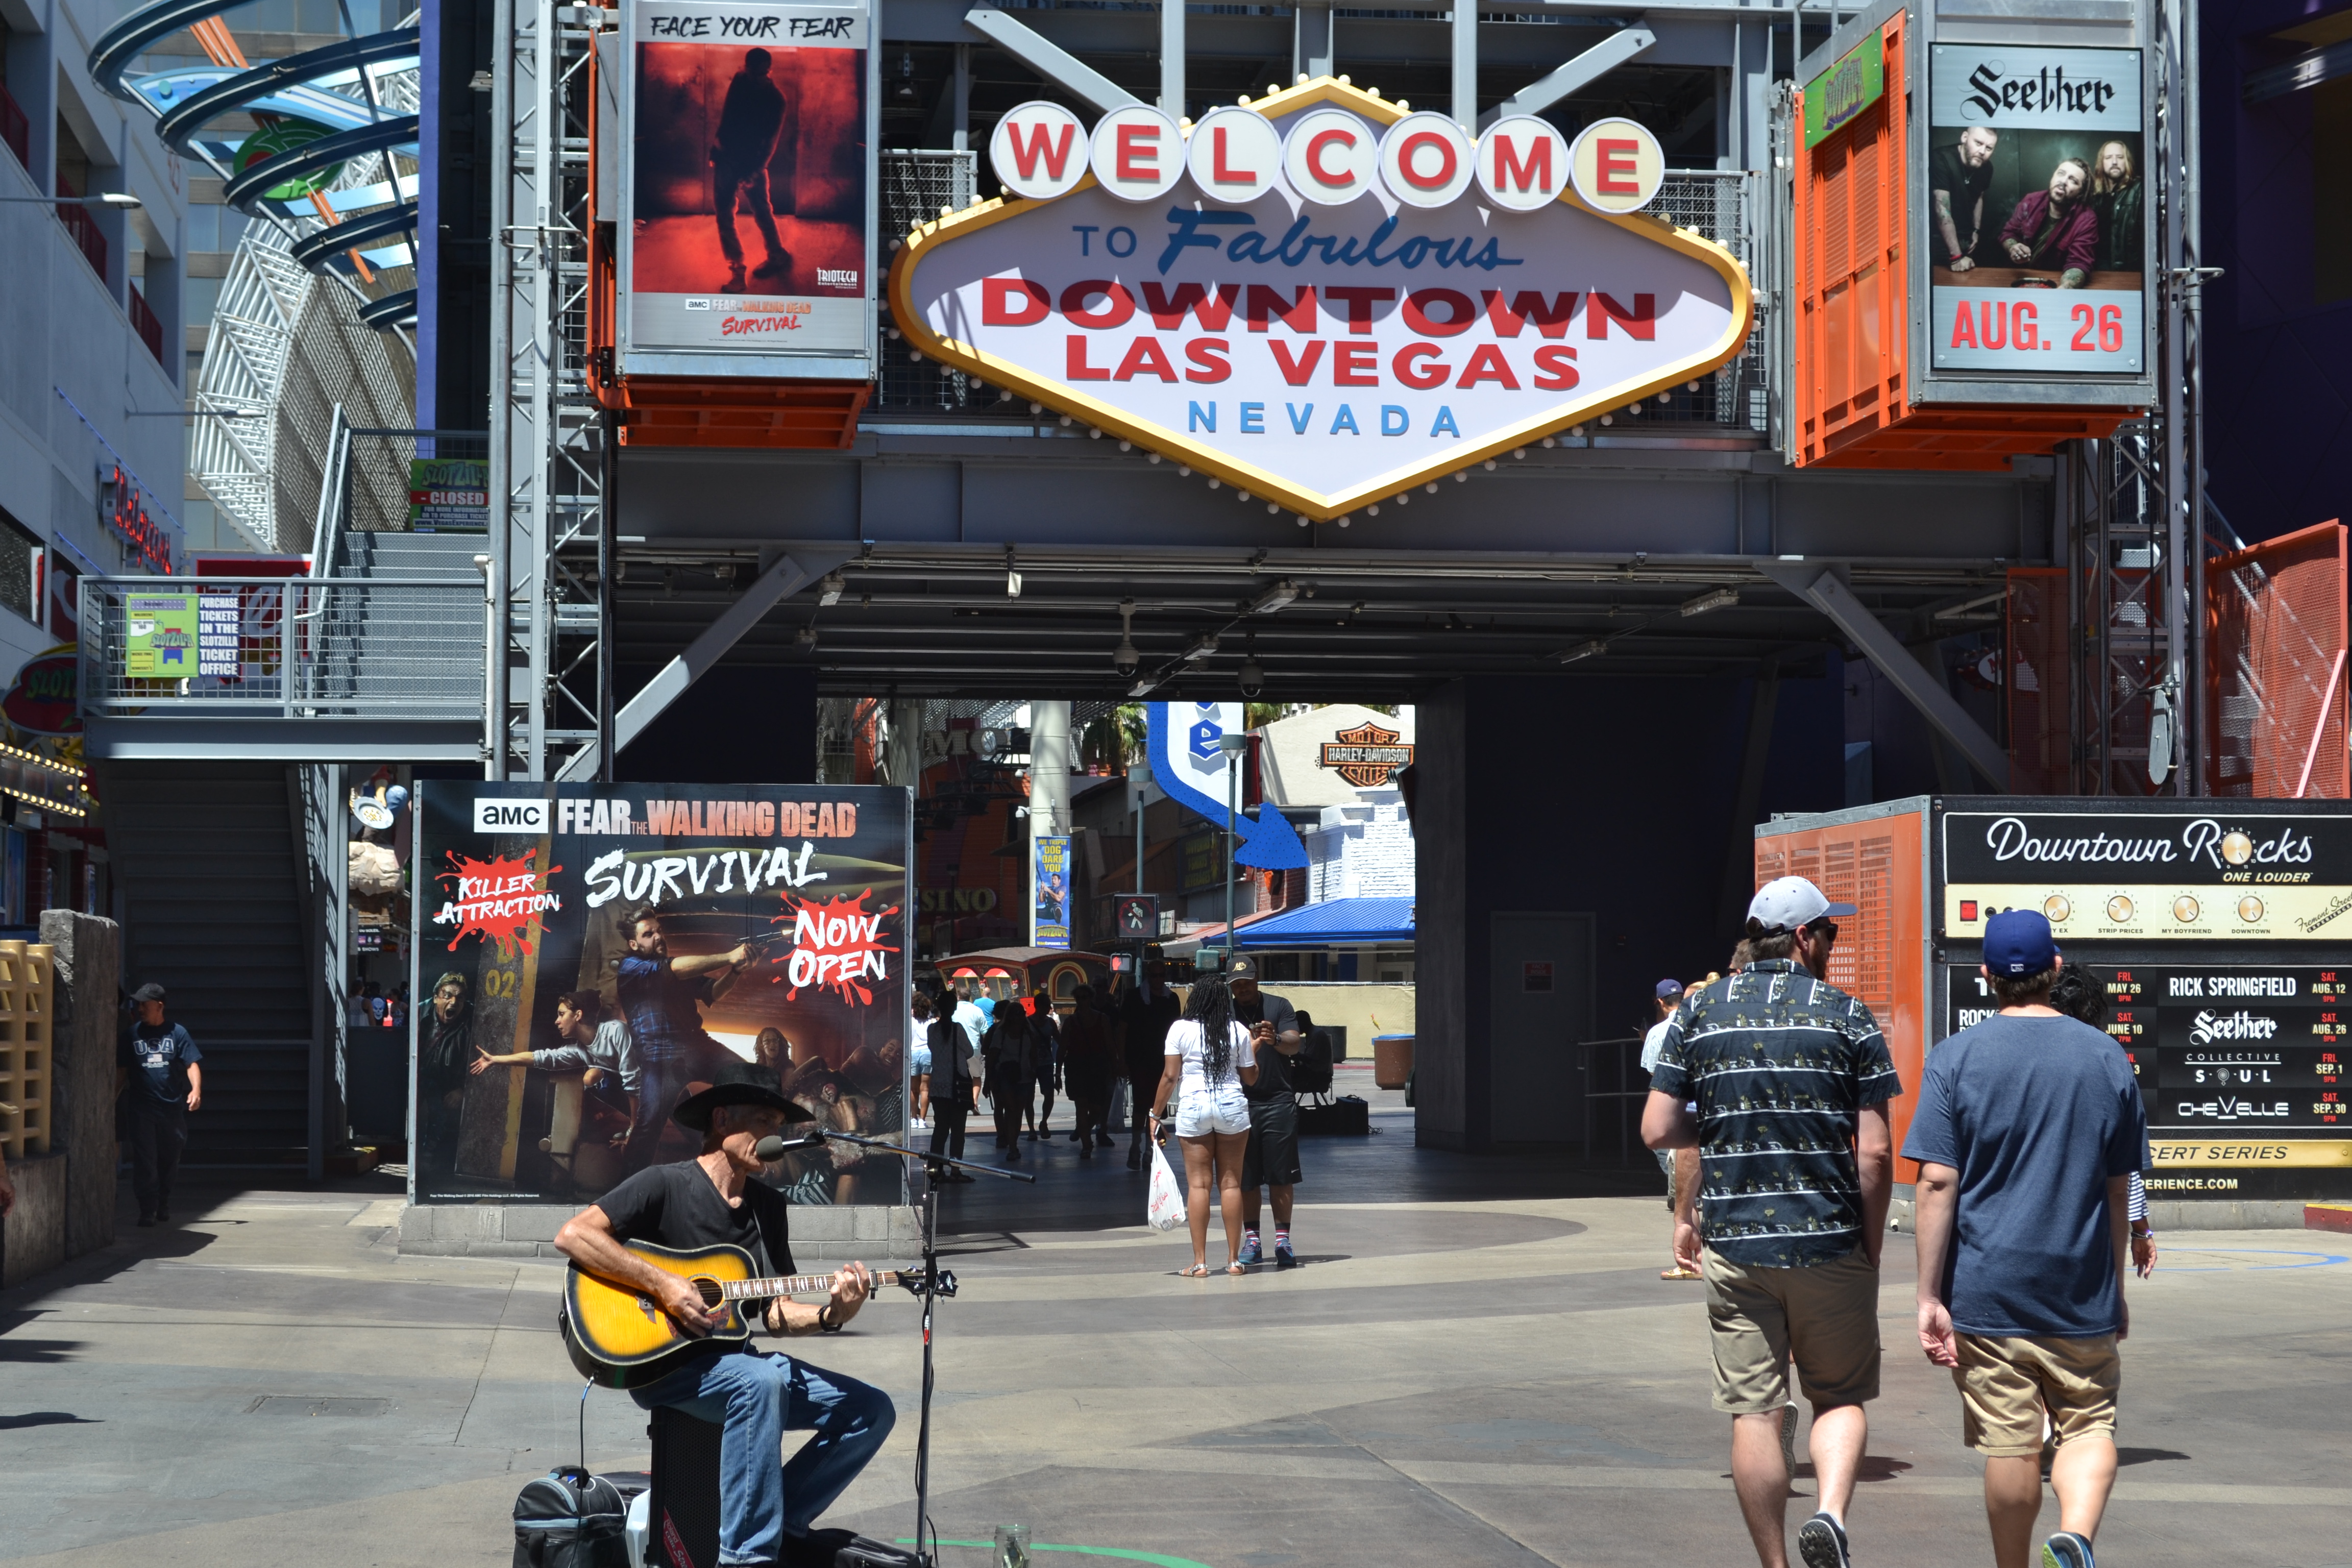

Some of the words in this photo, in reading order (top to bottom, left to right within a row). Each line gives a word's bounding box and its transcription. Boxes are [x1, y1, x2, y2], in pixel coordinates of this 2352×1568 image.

[651, 16, 712, 36] FACE
[720, 16, 780, 38] YOUR
[790, 17, 854, 39] FEAR
[1958, 60, 2116, 119] Seether
[1008, 122, 1639, 193] WELCOME
[1072, 226, 1138, 258] TO
[1159, 206, 1524, 276] Fabulous
[817, 268, 857, 282] TRIOTECH
[713, 300, 737, 311] FEAR
[743, 301, 784, 313] WALKING
[786, 302, 811, 313] DEAD
[982, 278, 1656, 341] DOWNTOWN
[722, 314, 801, 335] SURVIVAL
[1951, 301, 2051, 350] AUG.
[2071, 304, 2122, 352] 26
[1066, 335, 1232, 384] LAS
[1268, 340, 1580, 390] VEGAS
[1189, 400, 1460, 438] NEVADA
[430, 492, 484, 505] CLOSED
[200, 597, 238, 608] PURCHASE
[200, 610, 238, 621] TICKETS
[200, 623, 212, 633] IN
[214, 624, 238, 633] THE
[200, 636, 238, 646] SLOTZILLA
[200, 649, 238, 661] TICKET
[200, 664, 237, 675] OFFICE
[1348, 728, 1389, 743] MOTOR
[1329, 748, 1409, 762] HARLEY-DAVIDSON
[558, 799, 631, 834] FEAR
[631, 821, 648, 835] THE
[646, 800, 774, 837] WALKING
[781, 802, 856, 838] DEAD
[1987, 818, 2177, 862] Downtown
[1044, 846, 1061, 854] DOG
[1042, 855, 1063, 863] DARE
[584, 841, 827, 907] SURVIVAL
[1044, 864, 1061, 872] YOU
[2223, 872, 2252, 882] ONE
[2255, 872, 2311, 883] LOUDER
[458, 874, 535, 901] KILLER
[920, 888, 996, 912] SINO
[433, 894, 559, 924] ATTRACTION
[2294, 907, 2329, 932] Fremont
[794, 910, 881, 950] NOW
[789, 948, 885, 987] OPEN
[486, 969, 515, 998] 02
[2117, 972, 2133, 981] FRI.
[2321, 972, 2337, 982] SAT.
[2108, 983, 2127, 993] MAY
[2130, 984, 2141, 993] 26
[2169, 977, 2203, 996] RICK
[2209, 977, 2296, 996] SPRINGFIELD
[2312, 984, 2333, 994] AUG.
[2336, 984, 2346, 994] 12
[2117, 1013, 2134, 1022] SAT.
[2322, 1013, 2338, 1022] SAT.
[2105, 1024, 2130, 1035] JUNE
[2132, 1024, 2143, 1035] 10
[2188, 1009, 2278, 1045] Seether
[2312, 1024, 2334, 1035] AUG.
[2336, 1024, 2346, 1035] 26
[133, 1038, 174, 1055] USA
[2322, 1054, 2337, 1062] FRI.
[2316, 1064, 2335, 1074] SEP.
[2338, 1064, 2343, 1074] 1
[2323, 1093, 2338, 1102] SAT.
[2178, 1096, 2289, 1119] CHEVELLE
[2313, 1104, 2333, 1114] SEP.
[2335, 1104, 2346, 1114] 30
[2149, 1146, 2200, 1160] CERT
[2207, 1146, 2288, 1160] SERIES
[2141, 1179, 2238, 1190] PERIENCE.COM
[673, 1550, 688, 1568] Stre
